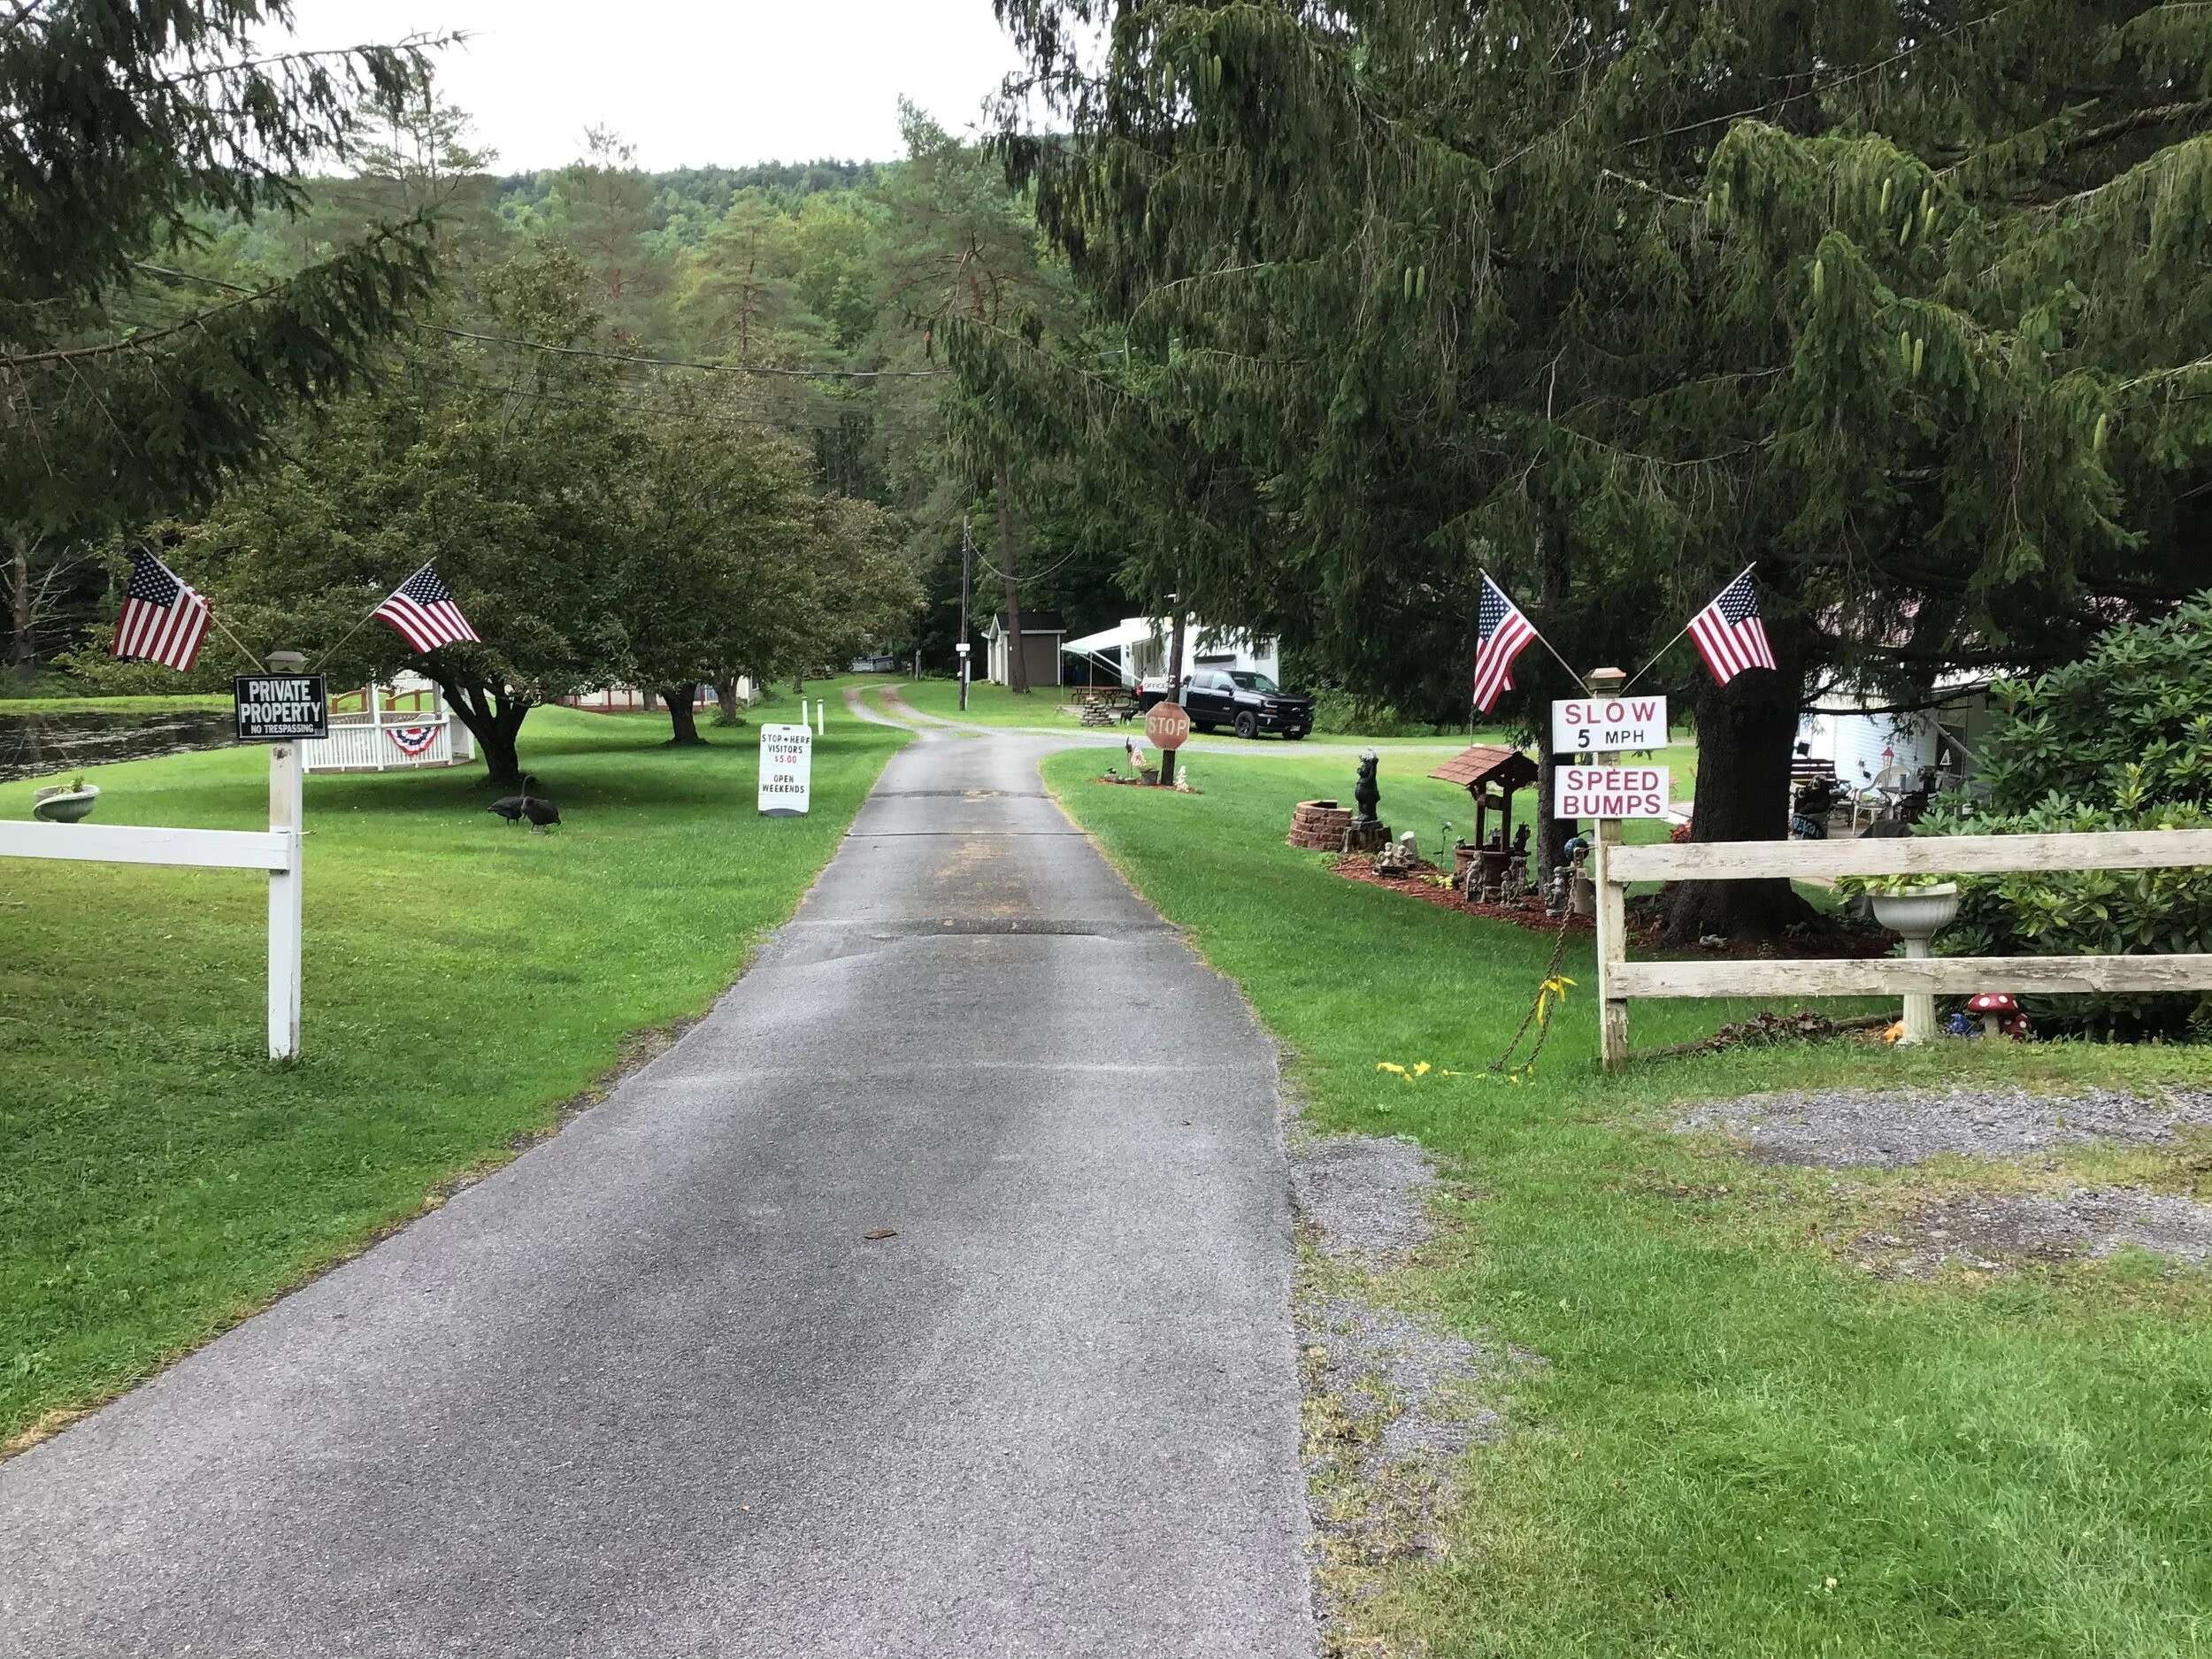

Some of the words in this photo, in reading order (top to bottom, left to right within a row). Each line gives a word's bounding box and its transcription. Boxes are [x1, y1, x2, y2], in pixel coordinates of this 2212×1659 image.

[249, 680, 311, 702] PRIVATE
[240, 702, 321, 723] PROPERTY
[1565, 702, 1656, 725] SLOW
[250, 725, 262, 733] NO
[264, 724, 314, 733] TRESPASSING
[1148, 717, 1187, 736] STOP
[1578, 728, 1590, 748] 5
[1605, 729, 1644, 744] MPH
[768, 744, 803, 754] VISITORS
[762, 784, 804, 794] WEEKENDS
[1567, 770, 1659, 791] SPEED
[1563, 794, 1661, 815] BUMPS
